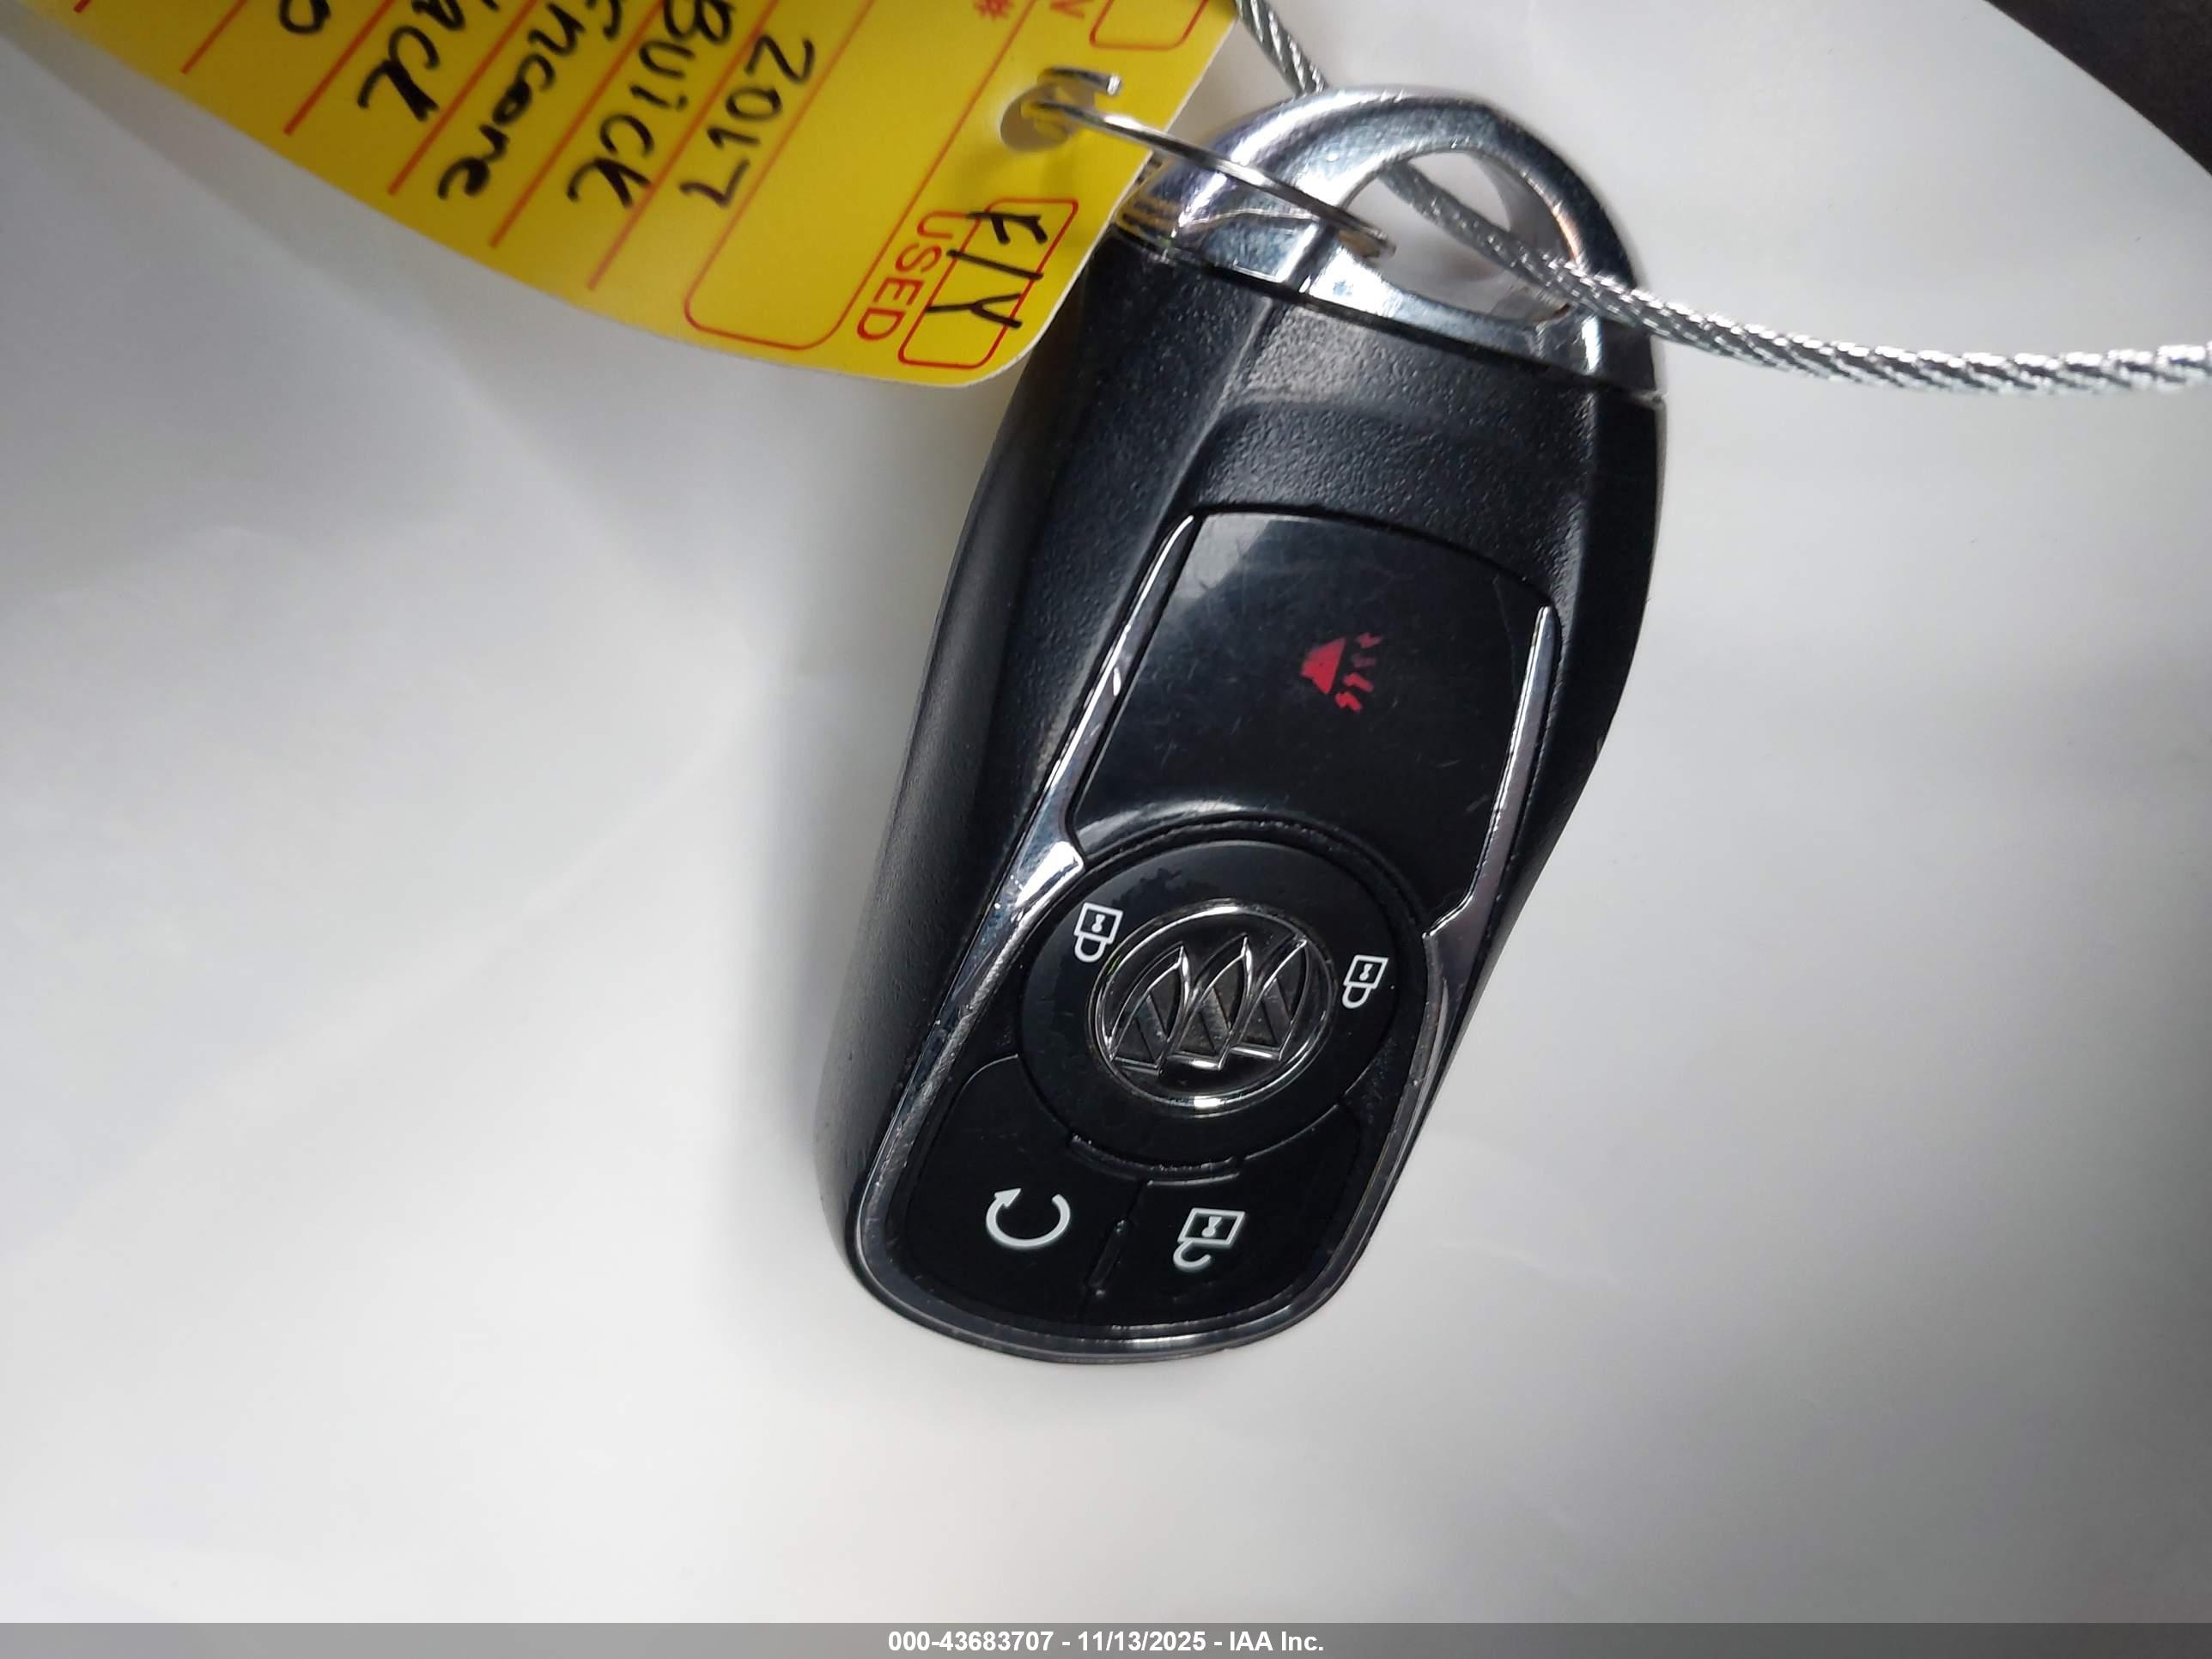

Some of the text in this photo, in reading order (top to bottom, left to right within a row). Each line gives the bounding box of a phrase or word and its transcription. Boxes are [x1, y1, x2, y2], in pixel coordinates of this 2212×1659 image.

[566, 0, 737, 207] Buick
[679, 33, 816, 207] 2017
[855, 210, 968, 343] USED
